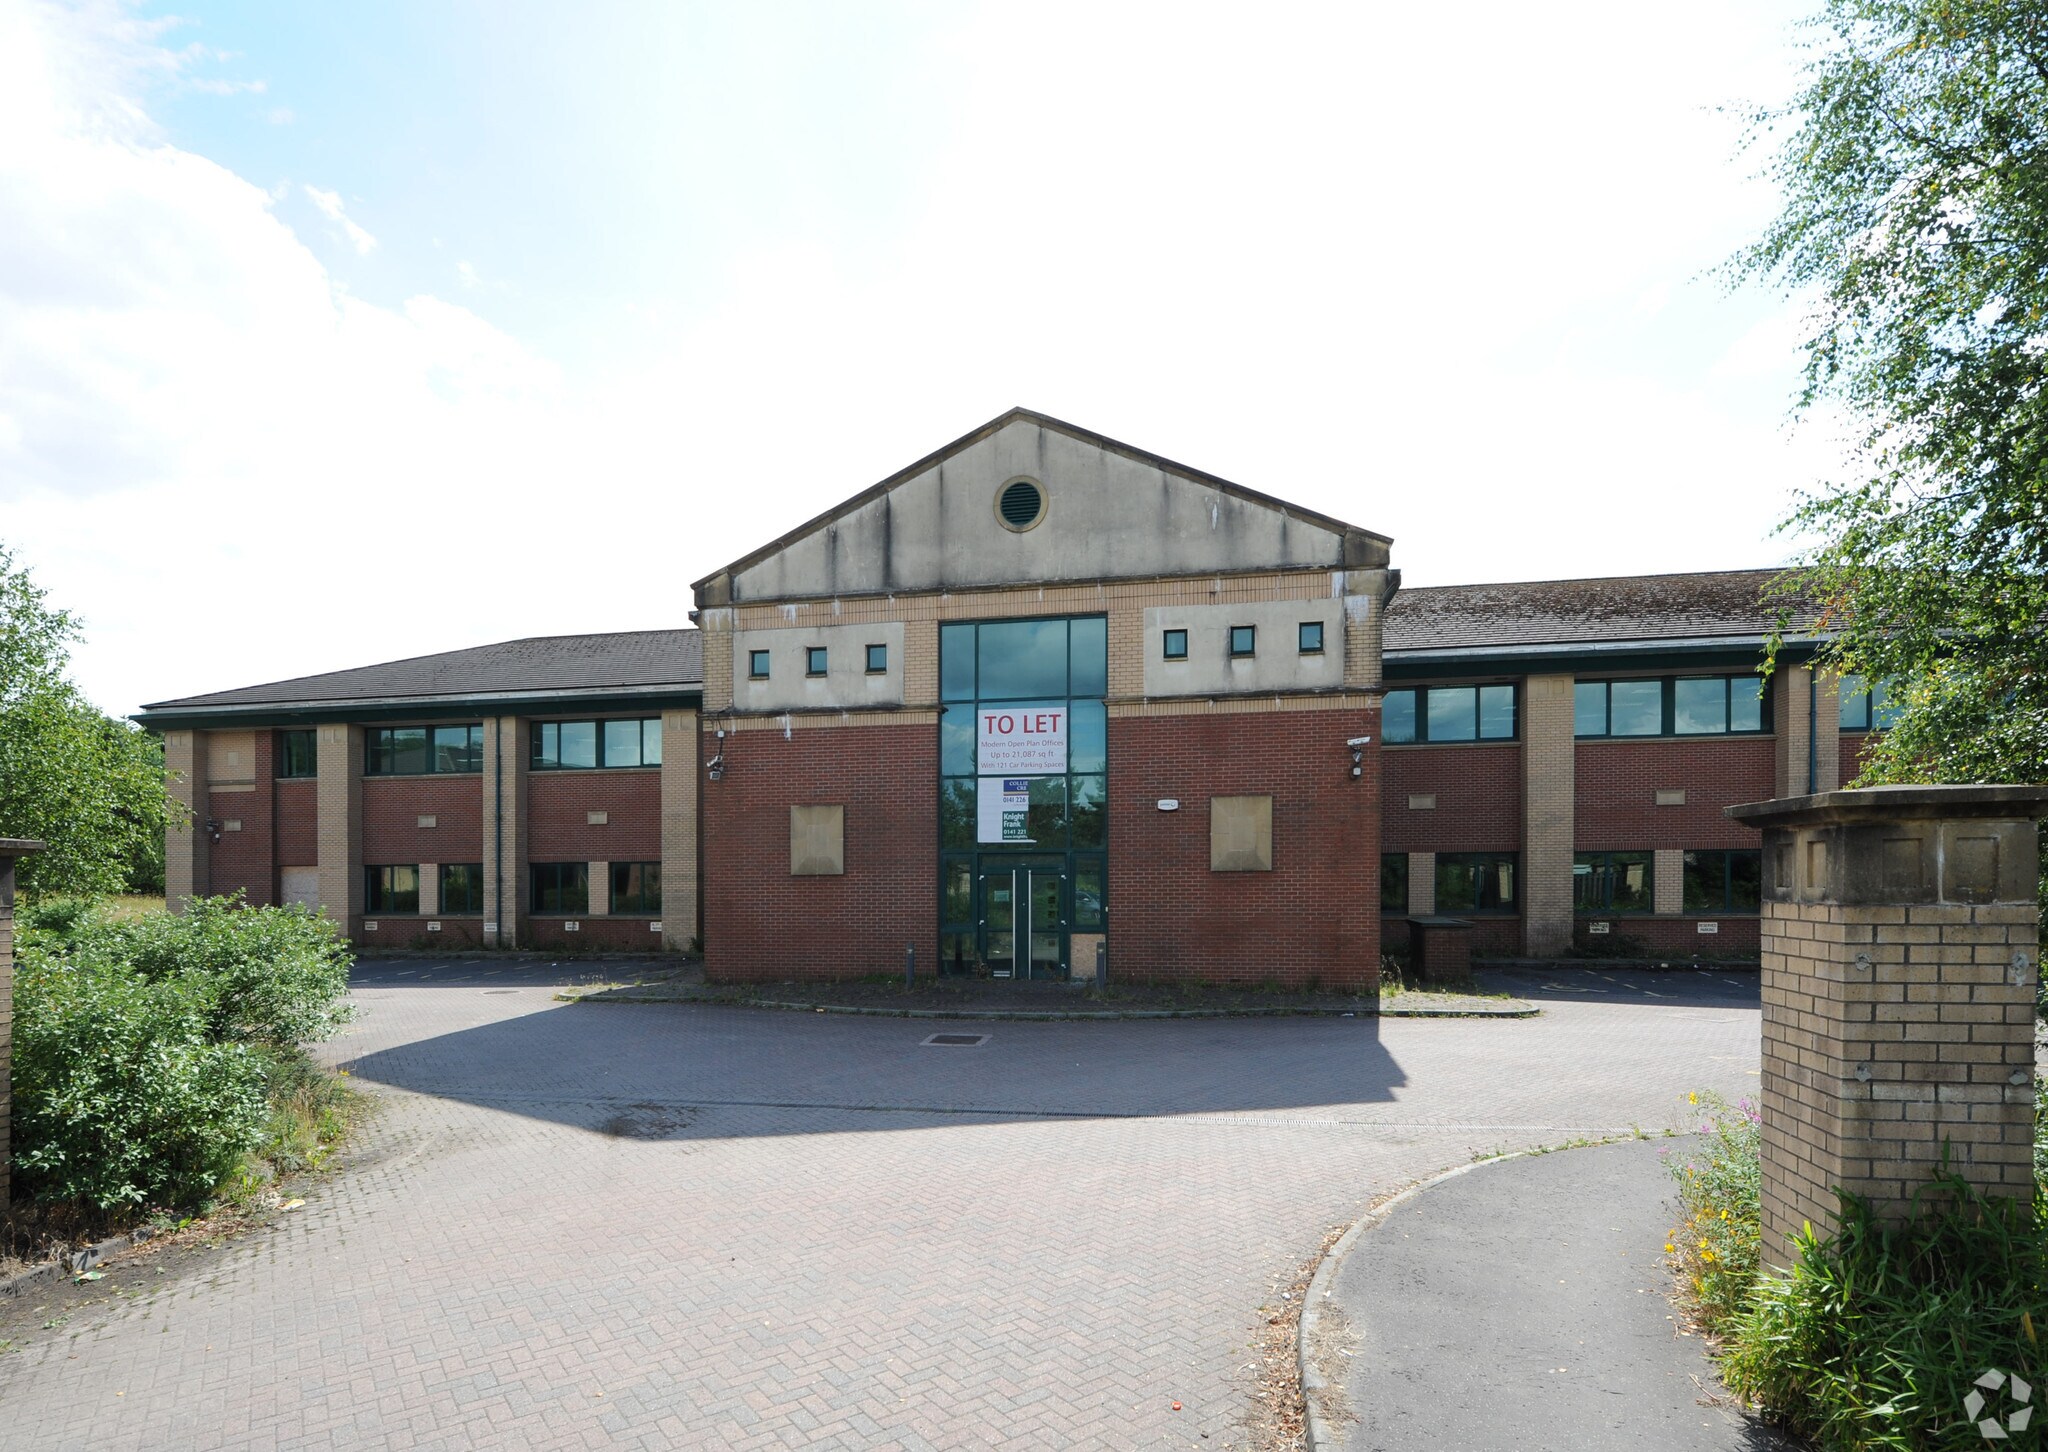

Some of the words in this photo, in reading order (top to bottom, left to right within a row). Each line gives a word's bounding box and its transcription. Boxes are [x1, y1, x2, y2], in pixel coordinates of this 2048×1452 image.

[984, 715, 1014, 734] TO
[1024, 714, 1061, 733] LET
[1004, 813, 1024, 821] Knight
